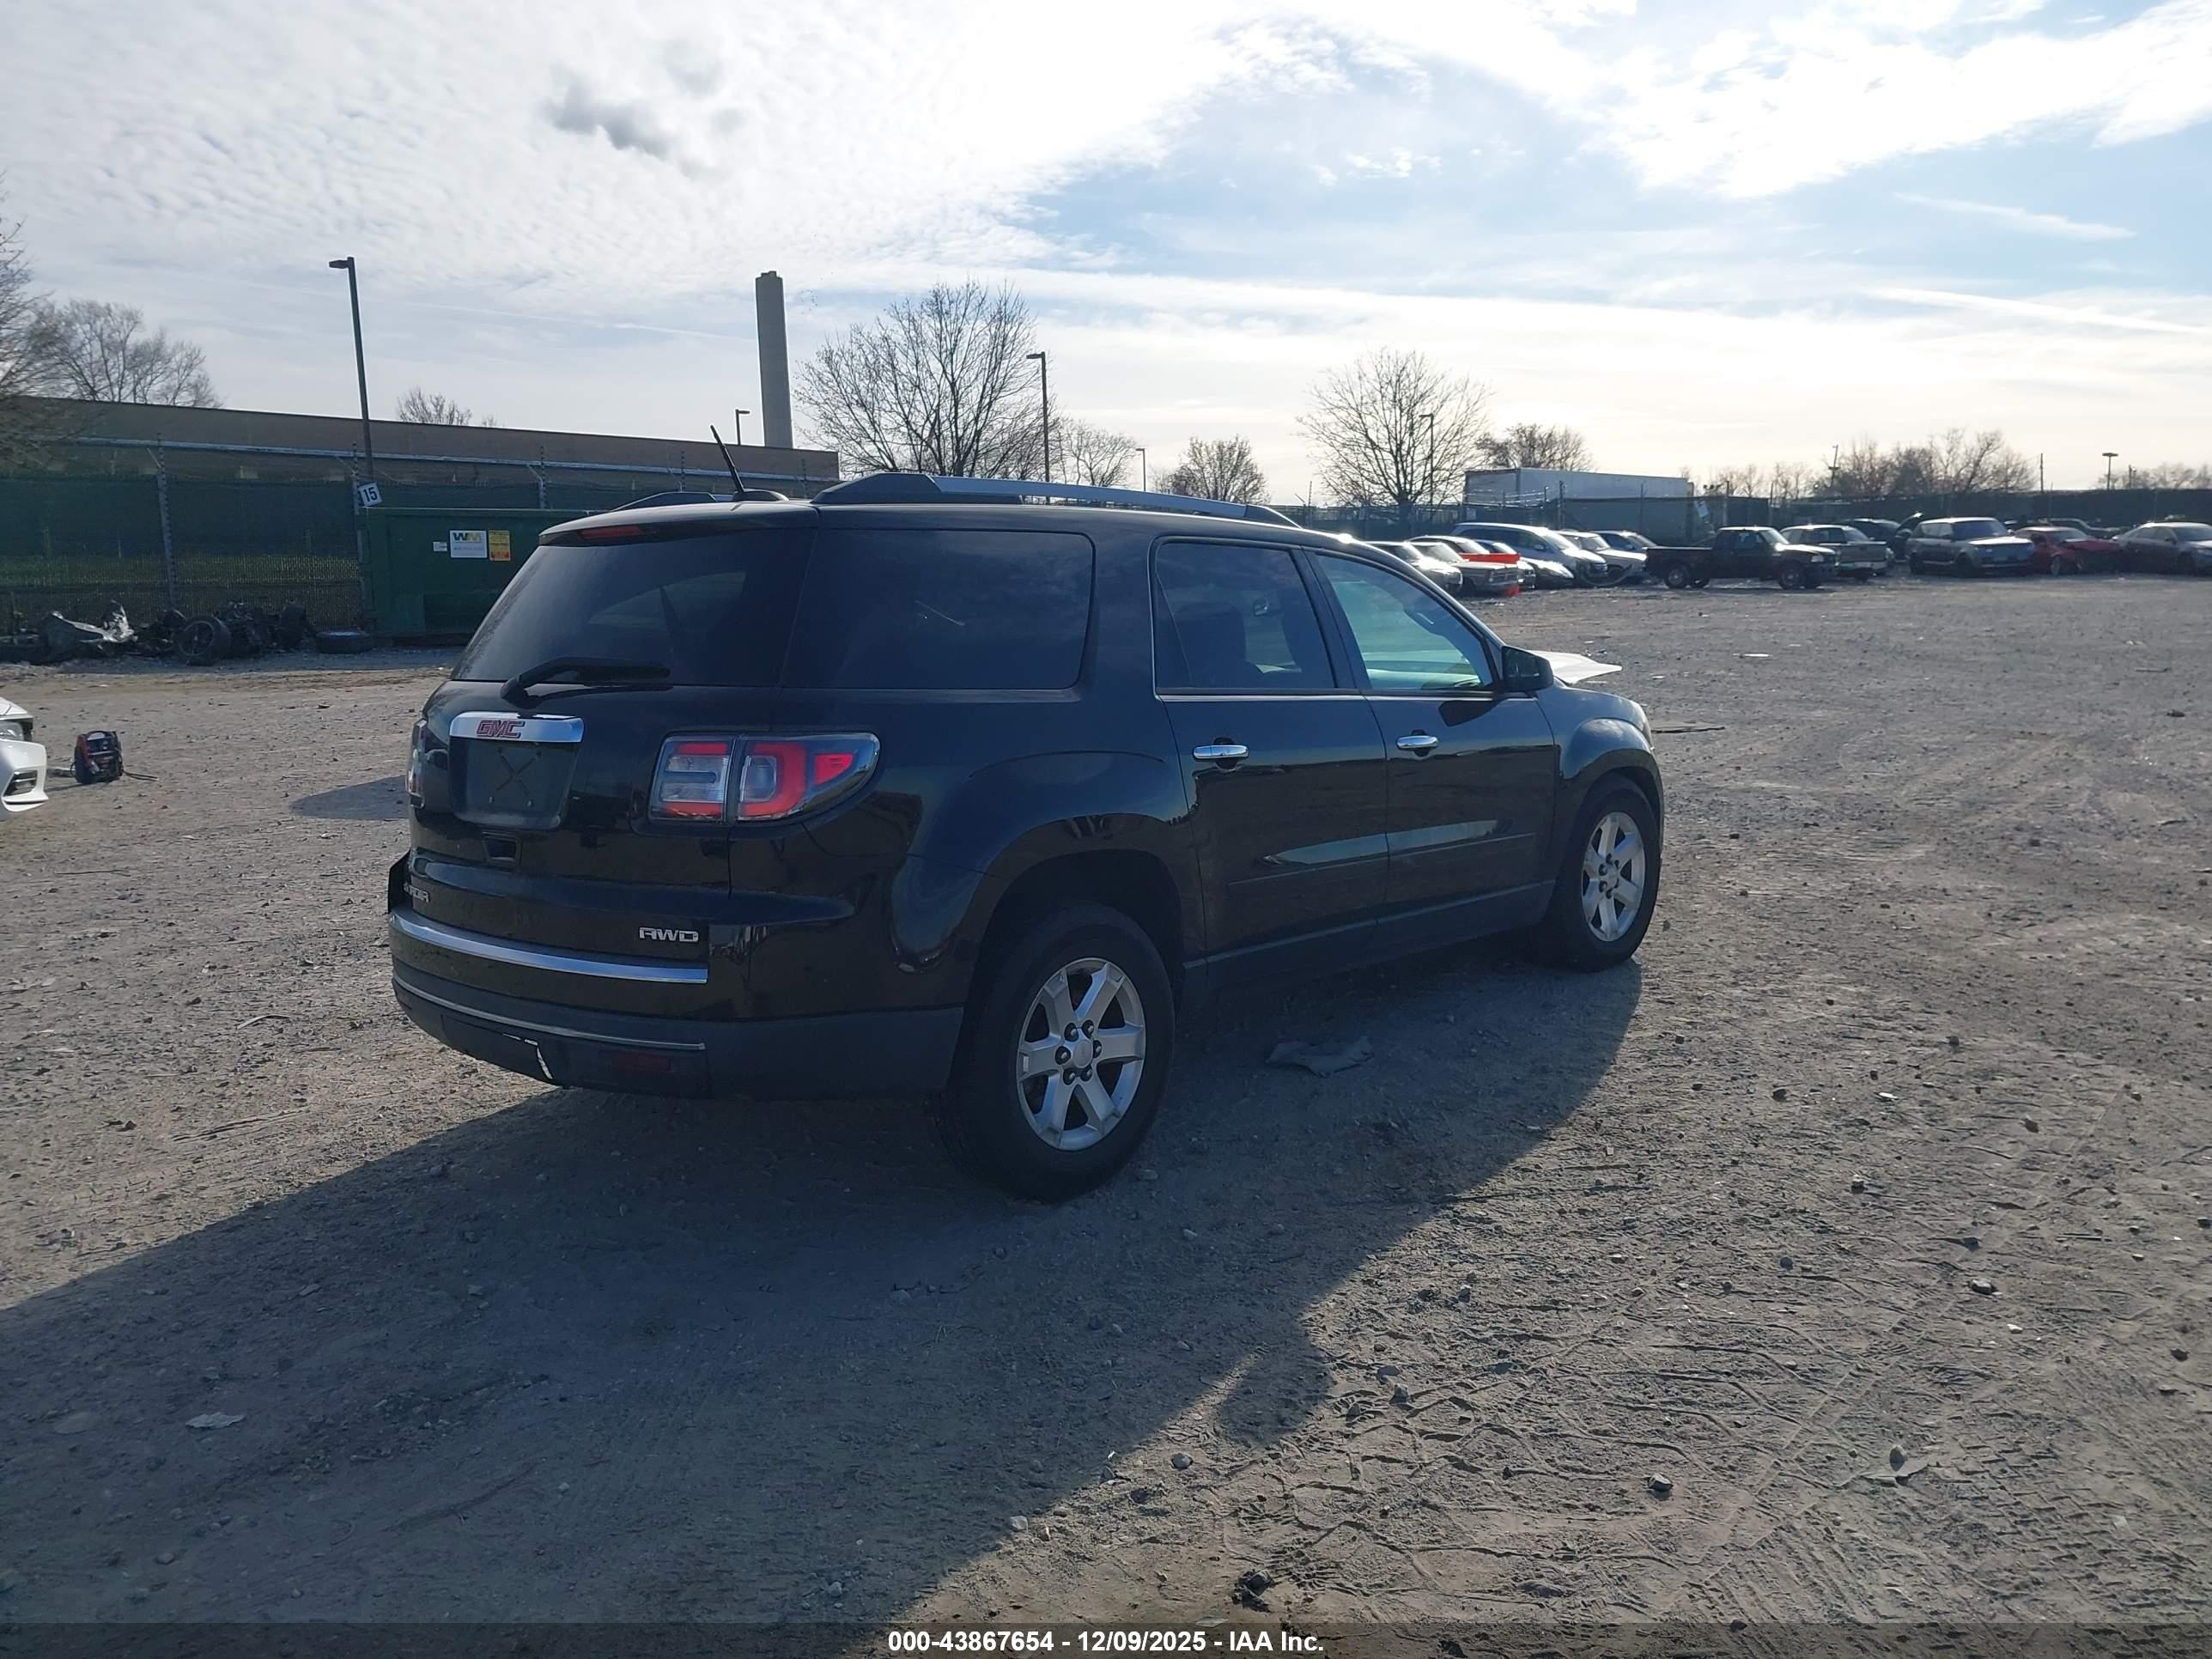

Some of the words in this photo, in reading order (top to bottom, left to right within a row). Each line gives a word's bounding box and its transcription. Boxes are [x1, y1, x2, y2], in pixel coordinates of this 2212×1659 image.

[363, 487, 378, 502] 15
[477, 720, 526, 738] GMC
[639, 927, 699, 942] AWD
